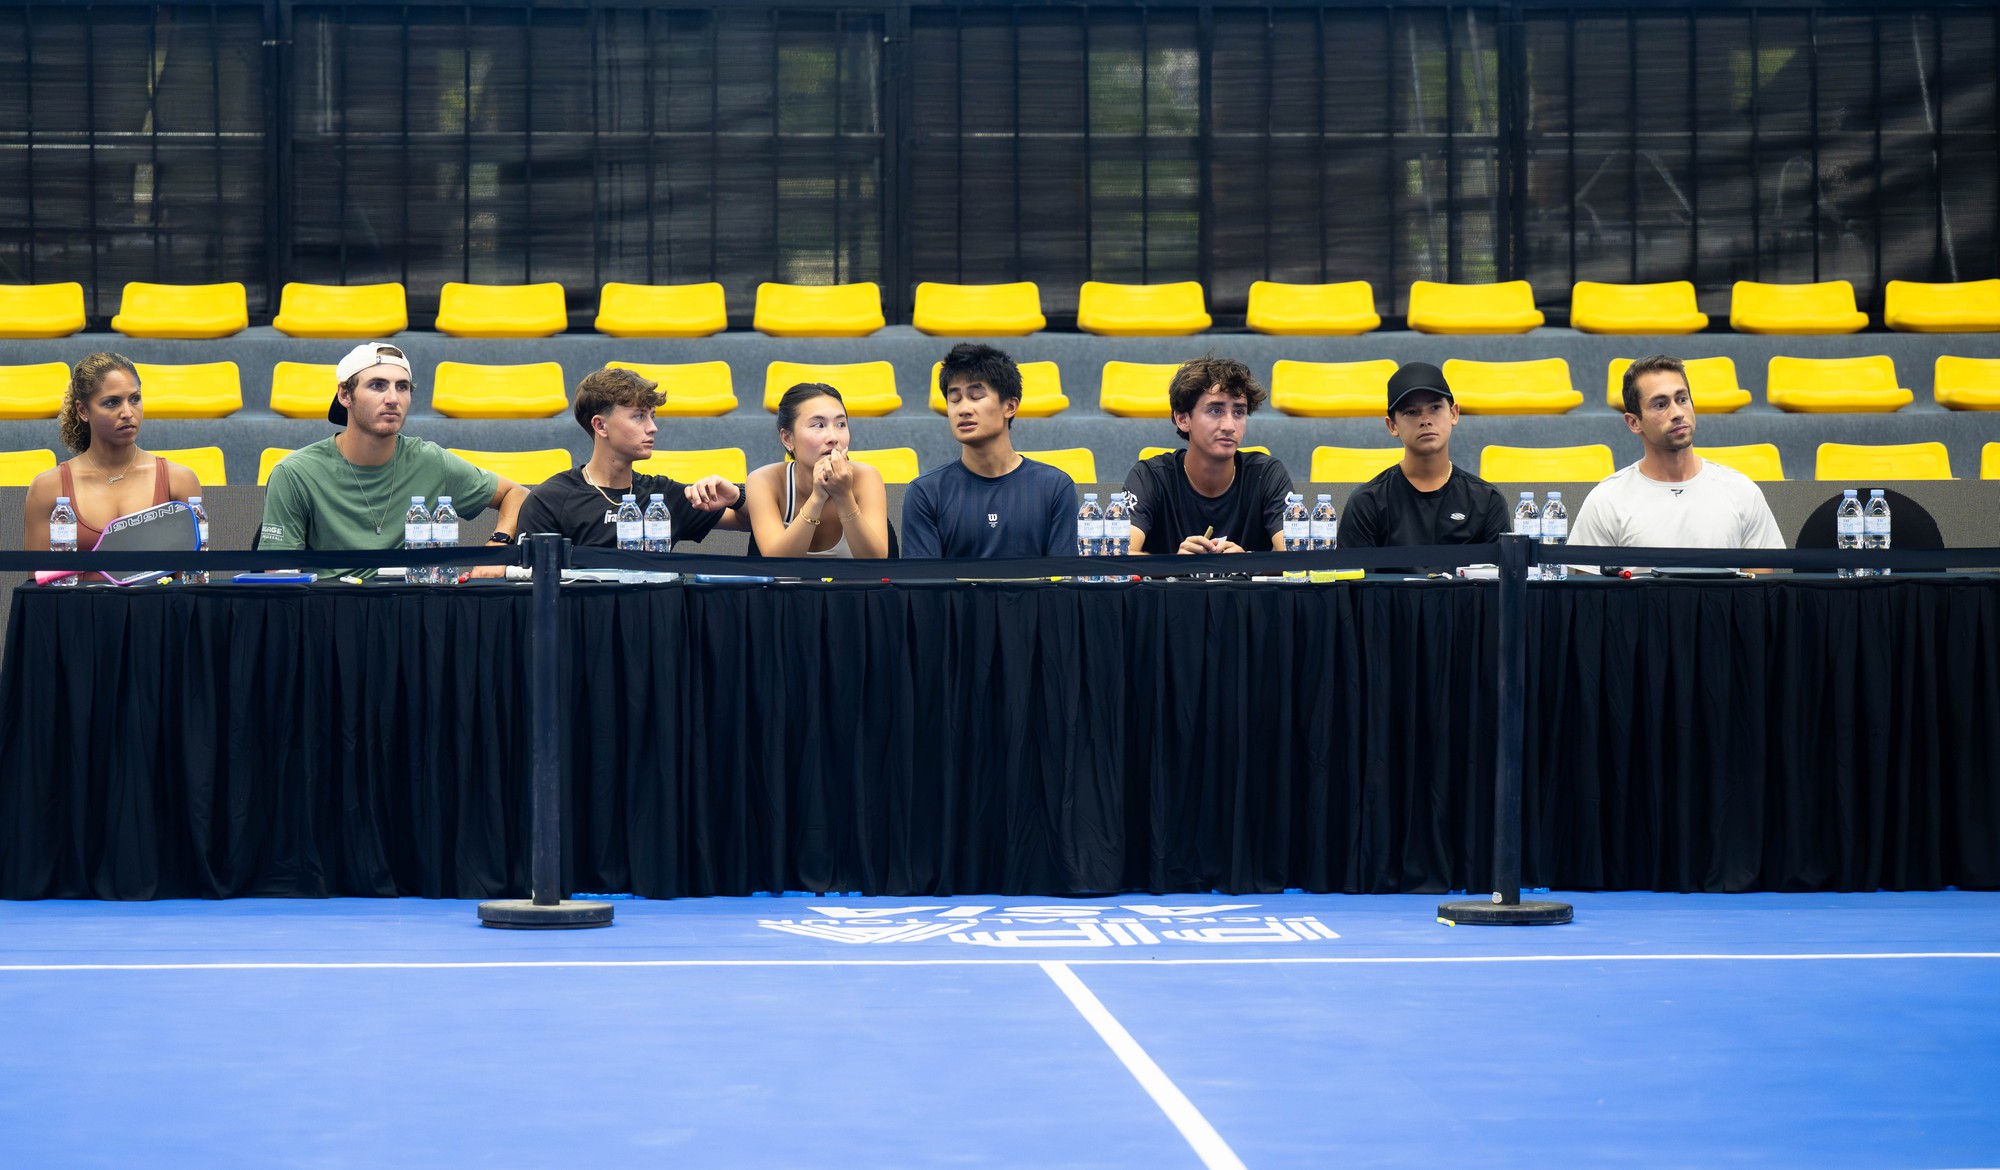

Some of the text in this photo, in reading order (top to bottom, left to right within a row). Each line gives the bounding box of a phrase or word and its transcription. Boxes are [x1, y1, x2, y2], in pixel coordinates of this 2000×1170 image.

[807, 904, 1262, 918] ASIA
[948, 916, 1318, 924] PICKLEBALL
[758, 920, 1341, 947] PPA
